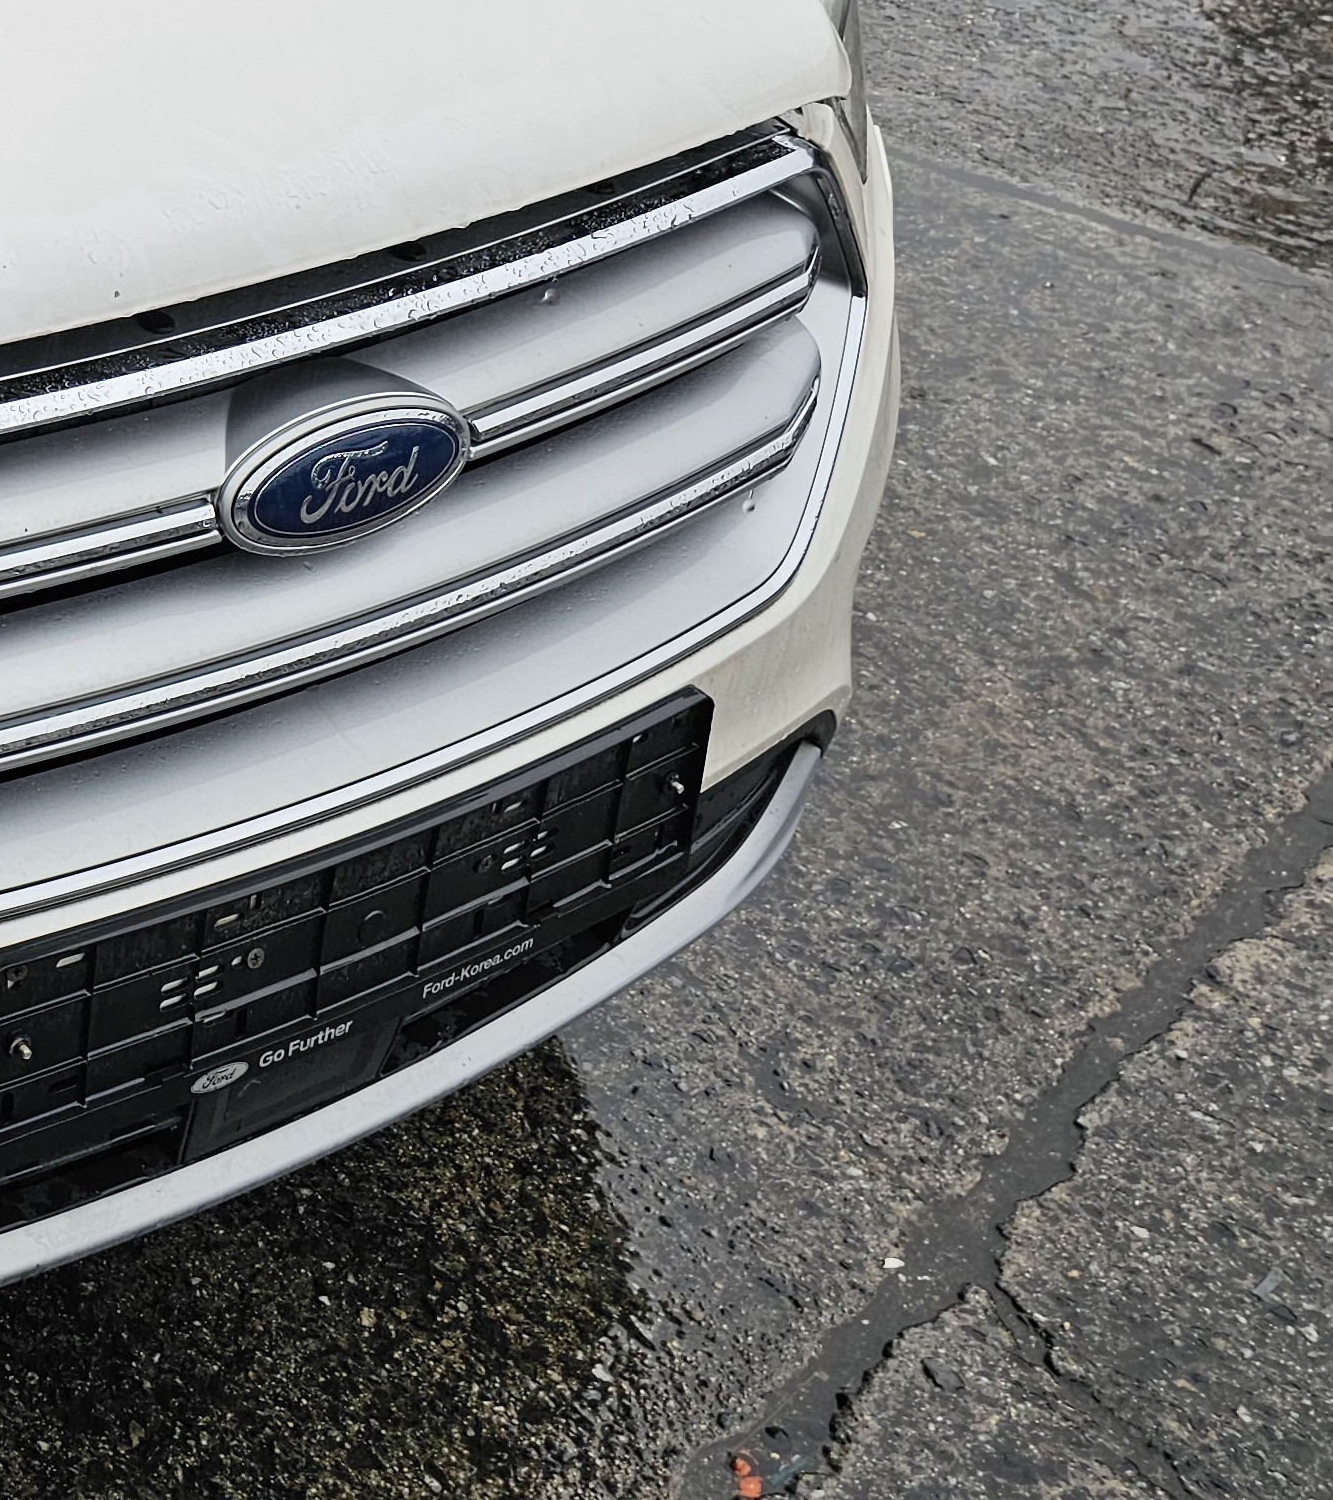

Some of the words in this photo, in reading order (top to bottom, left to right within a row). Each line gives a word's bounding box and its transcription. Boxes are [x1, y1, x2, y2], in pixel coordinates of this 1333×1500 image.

[300, 440, 420, 525] Ford
[422, 938, 534, 999] Ford-Korea.com
[259, 1049, 285, 1068] Go
[288, 1019, 354, 1057] Further
